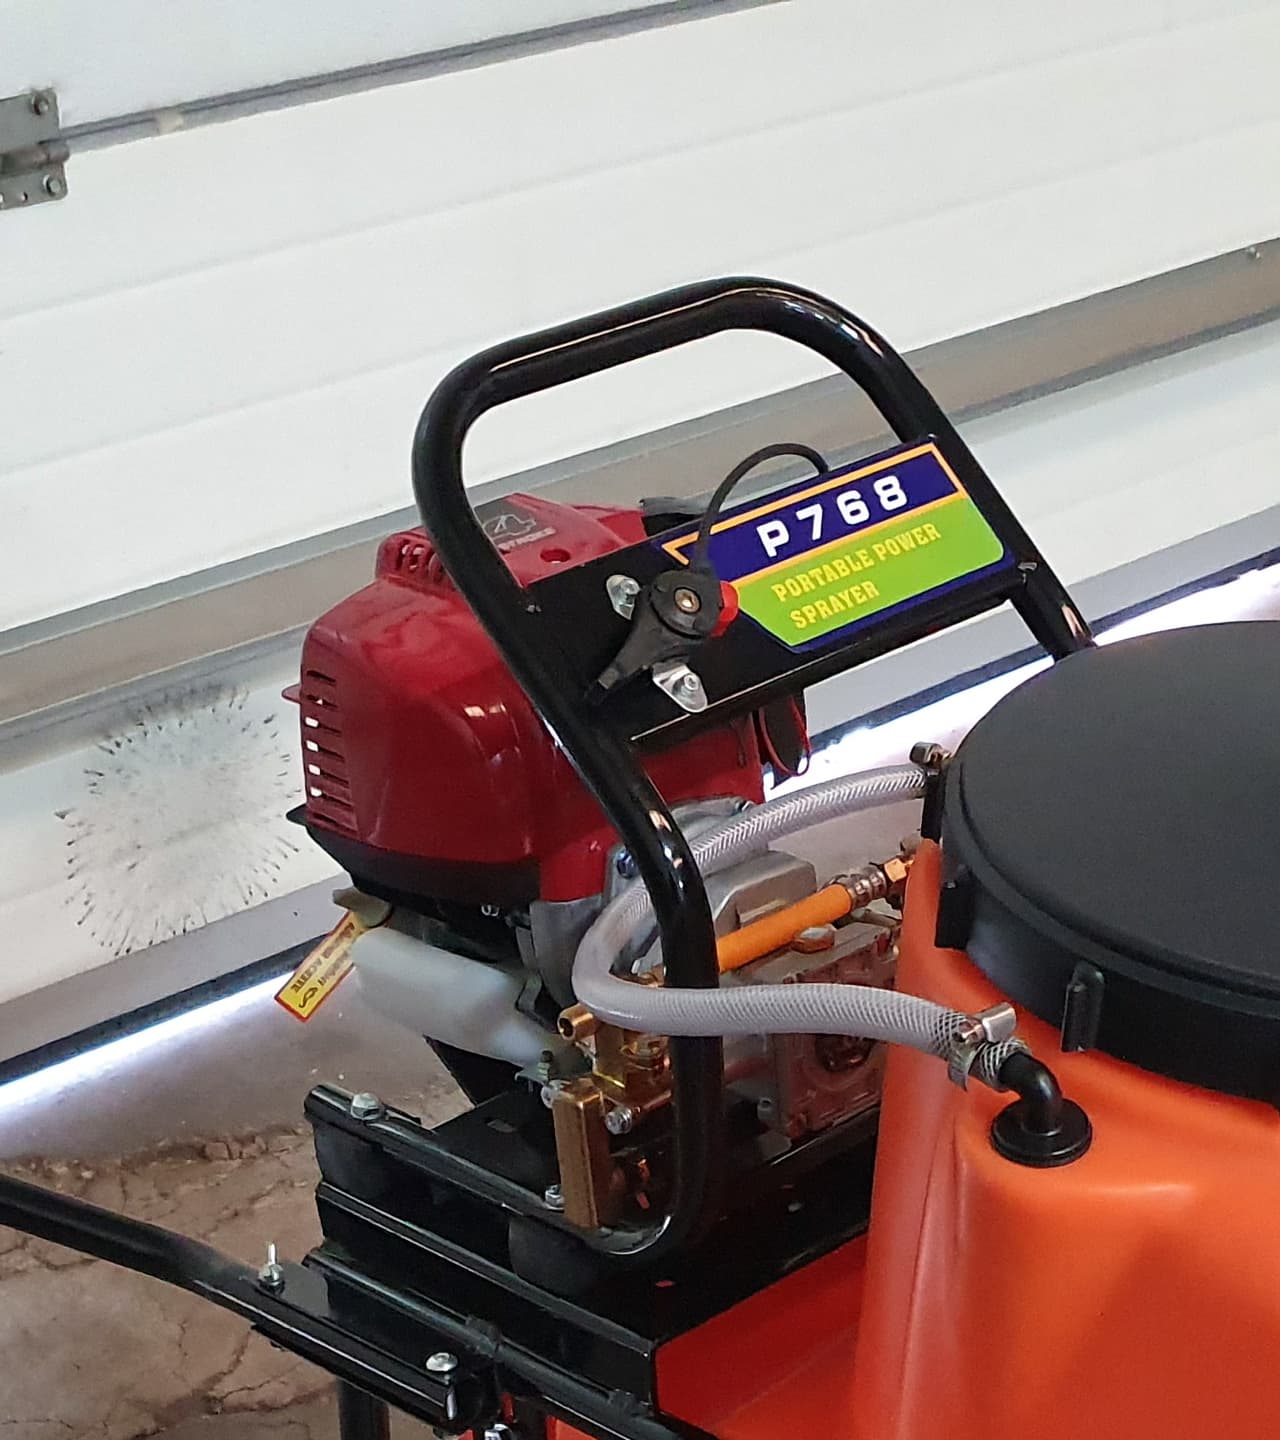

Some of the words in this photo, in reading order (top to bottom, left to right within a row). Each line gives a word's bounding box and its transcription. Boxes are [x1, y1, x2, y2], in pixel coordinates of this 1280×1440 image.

[756, 475, 908, 557] P768
[770, 543, 875, 602] PORTABLE
[872, 523, 942, 561] POWER
[789, 580, 880, 629] SPRAYER
